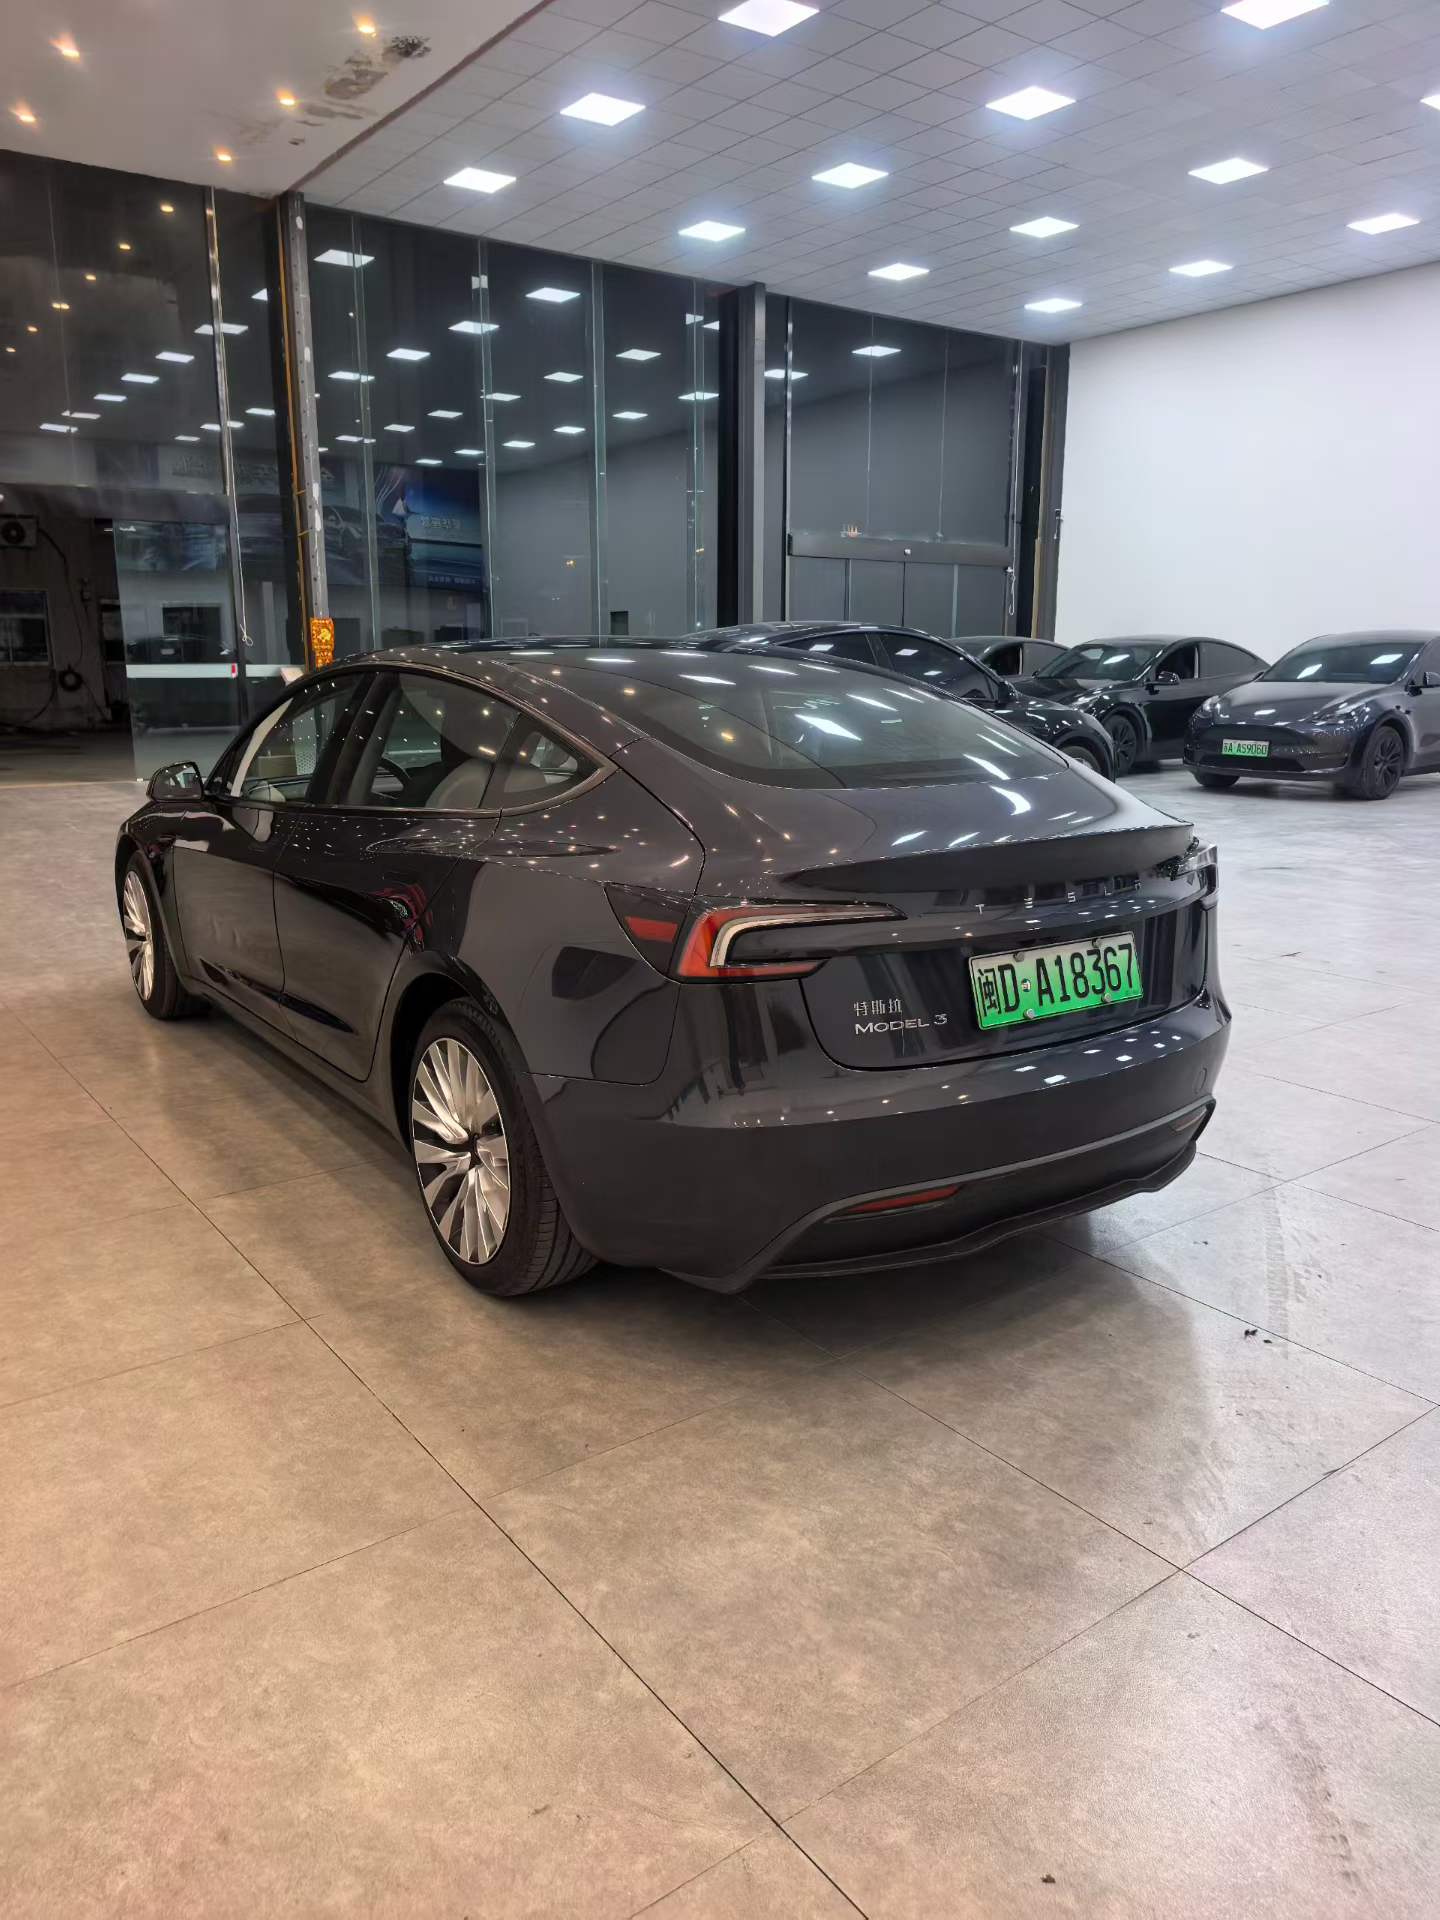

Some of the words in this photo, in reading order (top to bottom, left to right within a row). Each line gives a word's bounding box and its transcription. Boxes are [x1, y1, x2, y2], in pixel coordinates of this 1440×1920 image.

[975, 879, 1142, 915] TESLA
[855, 1018, 930, 1035] MODEL
[933, 1013, 948, 1025] 3
